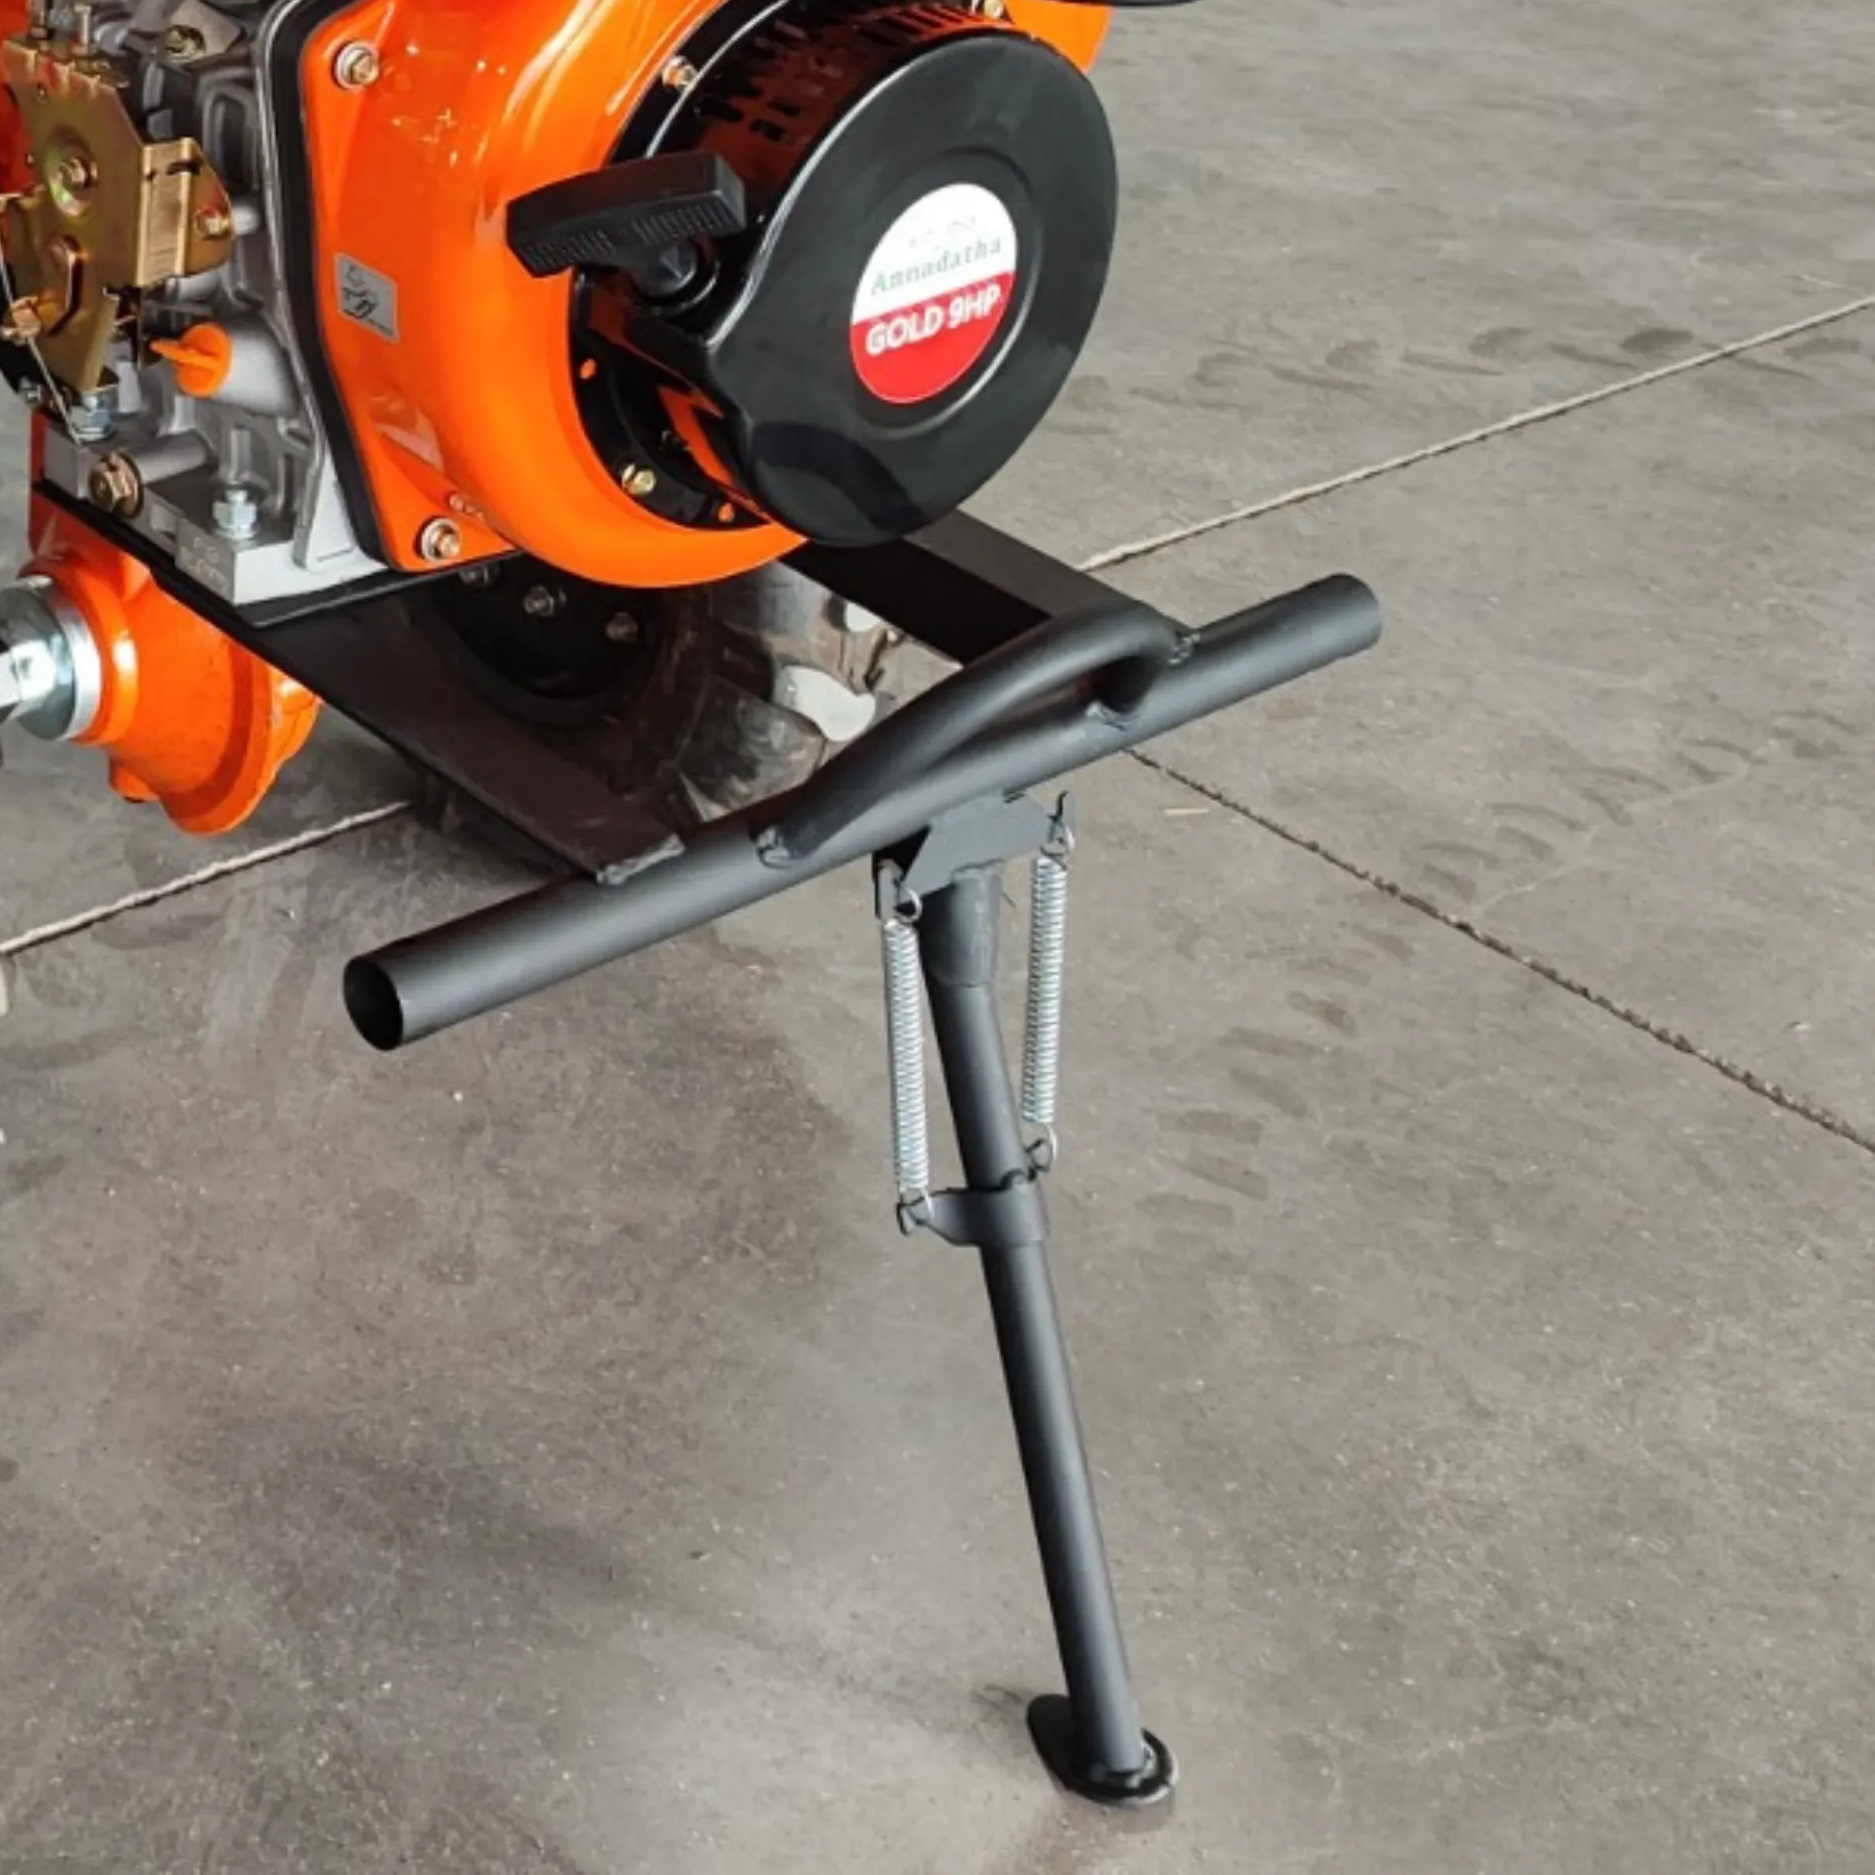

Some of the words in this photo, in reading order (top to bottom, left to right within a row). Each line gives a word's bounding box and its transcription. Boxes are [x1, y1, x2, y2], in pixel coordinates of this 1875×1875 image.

[871, 236, 1002, 296] Annadatha
[865, 303, 945, 358] GOLD
[947, 282, 1002, 330] 9HP
